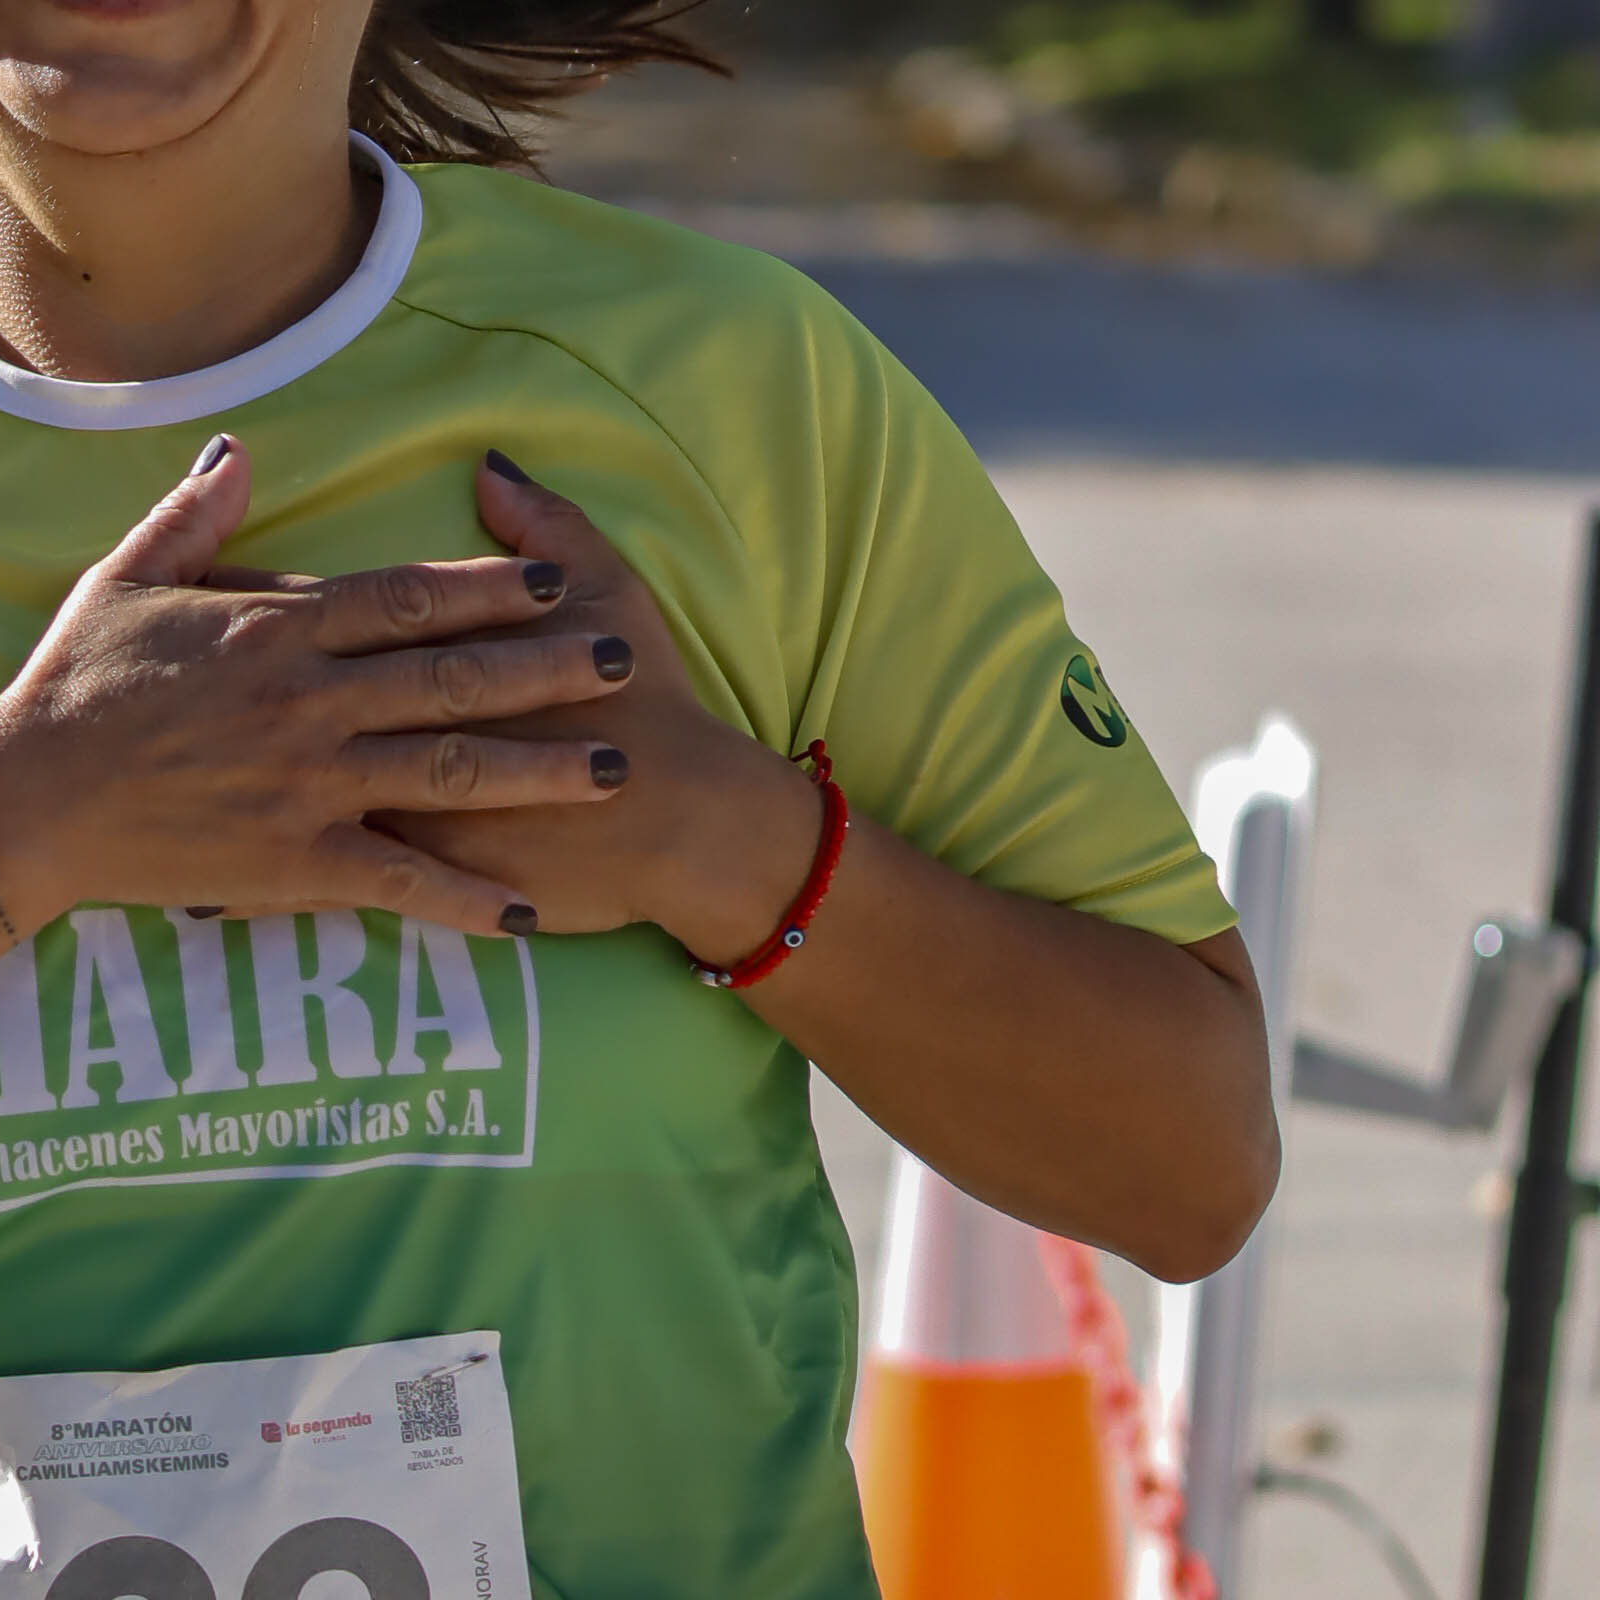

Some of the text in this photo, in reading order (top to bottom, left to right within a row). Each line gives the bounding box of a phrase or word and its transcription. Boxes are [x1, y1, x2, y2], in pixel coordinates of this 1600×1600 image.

[177, 1096, 413, 1159] Mayoristas
[424, 1088, 501, 1137] S.A.
[285, 1411, 373, 1437] la segunda
[33, 1433, 213, 1462] ANIVERSARIO
[15, 1452, 230, 1482] CAWILLIAMSKEMMIS
